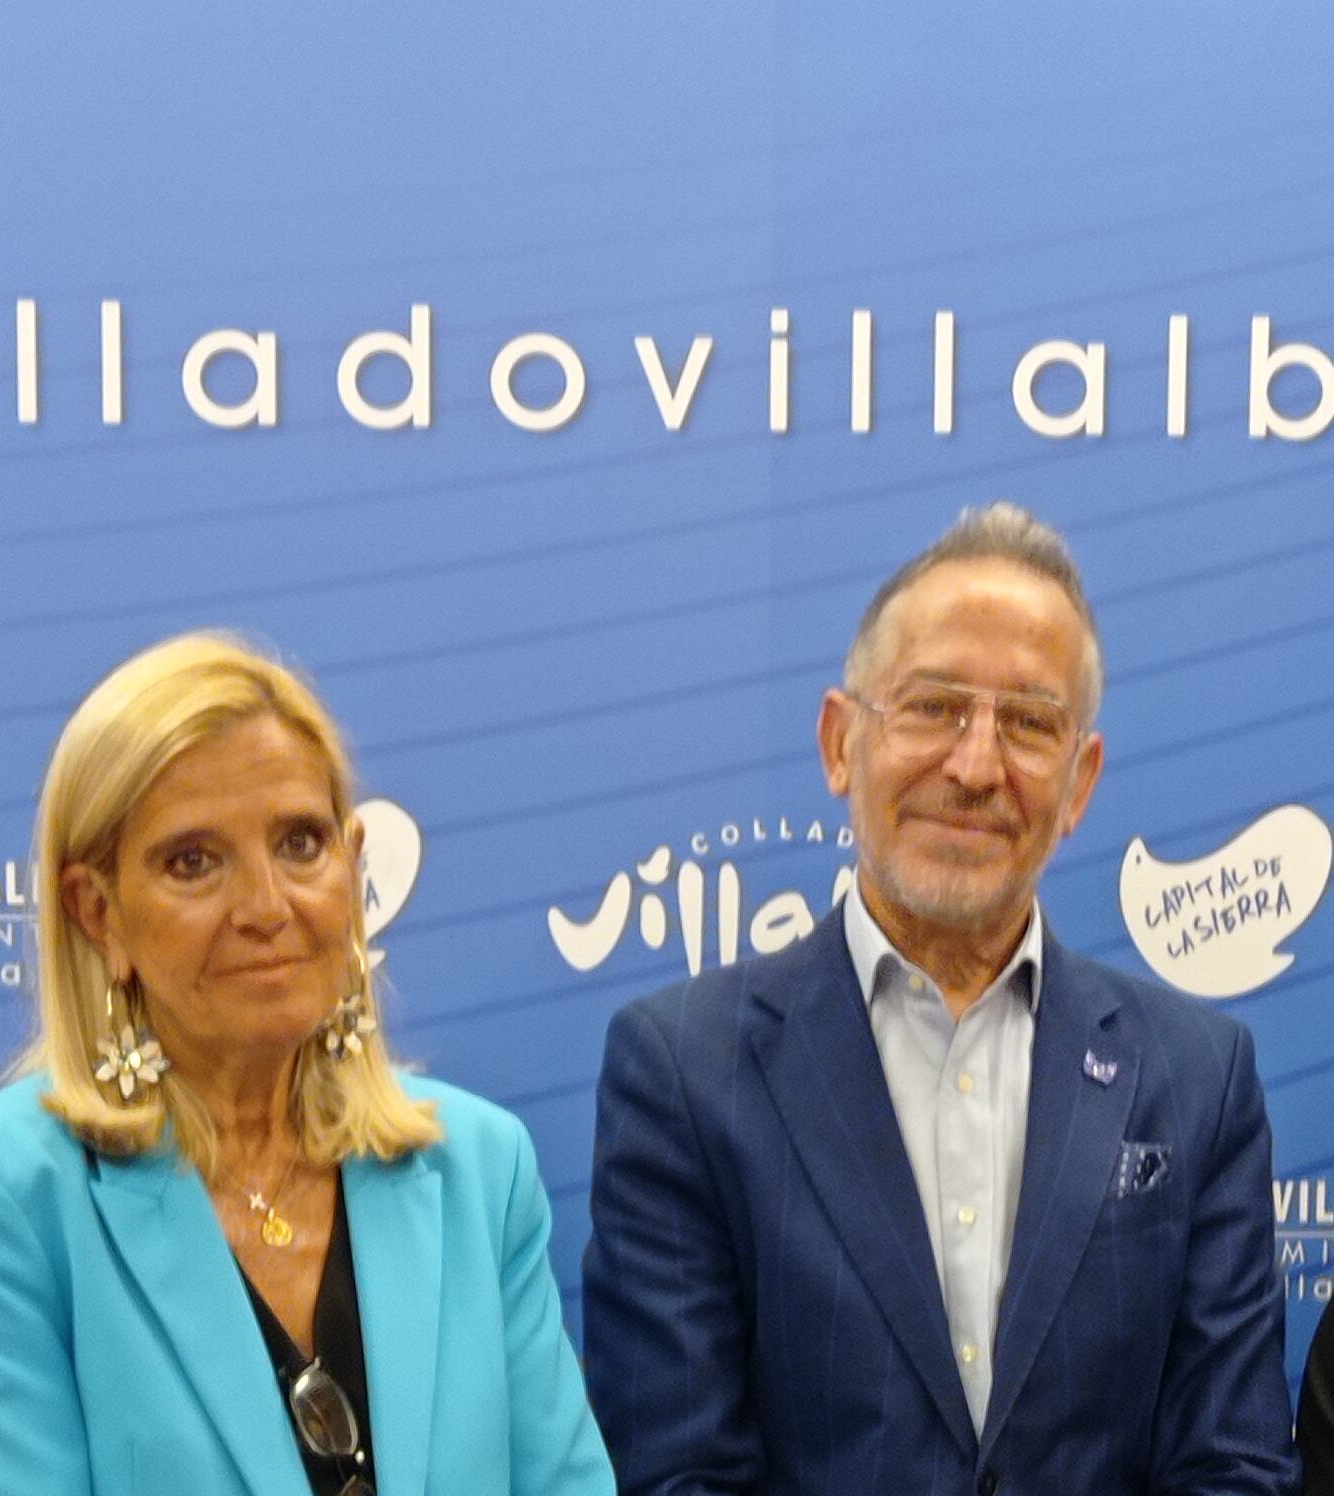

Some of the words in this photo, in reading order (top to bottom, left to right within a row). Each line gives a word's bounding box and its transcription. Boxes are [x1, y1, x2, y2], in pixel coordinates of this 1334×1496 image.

[691, 817, 854, 855] COLLAD
[547, 845, 854, 978] villa
[1145, 866, 1249, 928] CAPITAL
[1253, 855, 1282, 877] DE
[1167, 928, 1195, 959] LA
[1194, 881, 1292, 942] SIERRA
